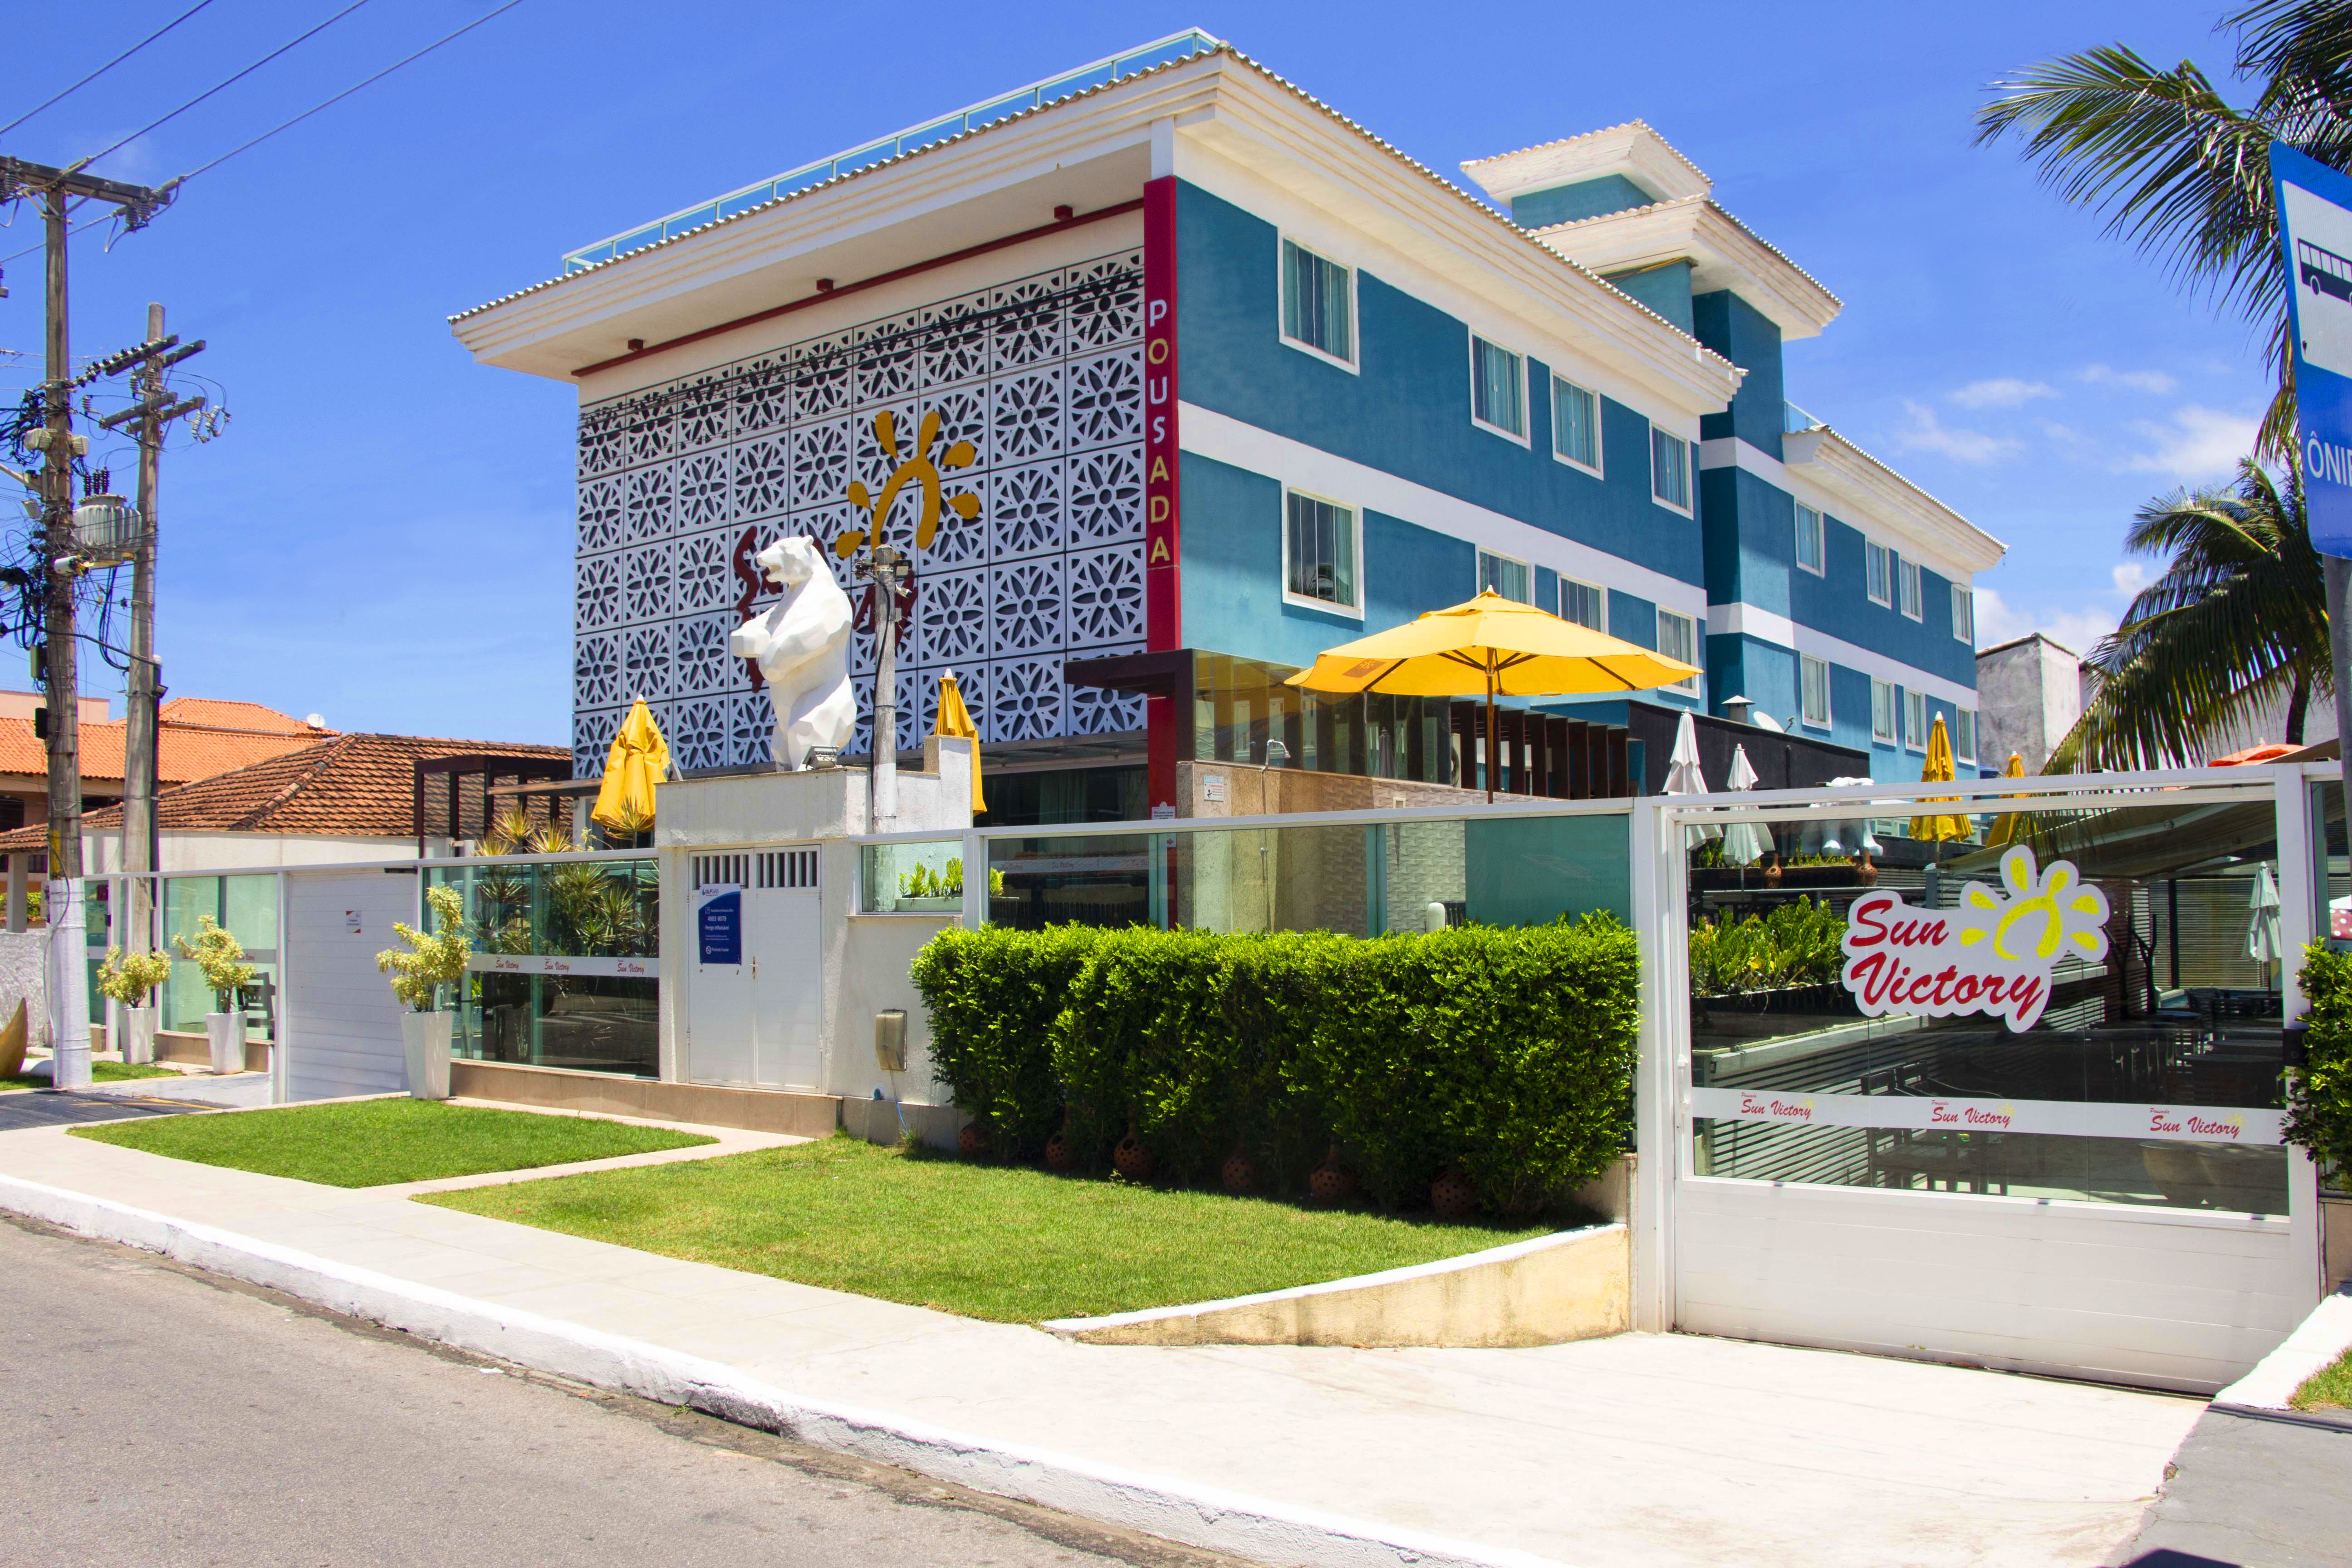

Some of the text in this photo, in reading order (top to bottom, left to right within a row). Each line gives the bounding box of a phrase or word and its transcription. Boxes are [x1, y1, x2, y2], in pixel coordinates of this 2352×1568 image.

[1148, 299, 1169, 563] POUSADA
[1850, 899, 1949, 947] Sun
[544, 961, 569, 973] Sun Victory
[617, 963, 644, 975] Sun Victory
[1851, 951, 2044, 1021] Victory
[1741, 1099, 1812, 1120] Sun Victory
[1931, 1107, 2011, 1128] Sun Victory
[2150, 1115, 2240, 1139] Sun Victory
